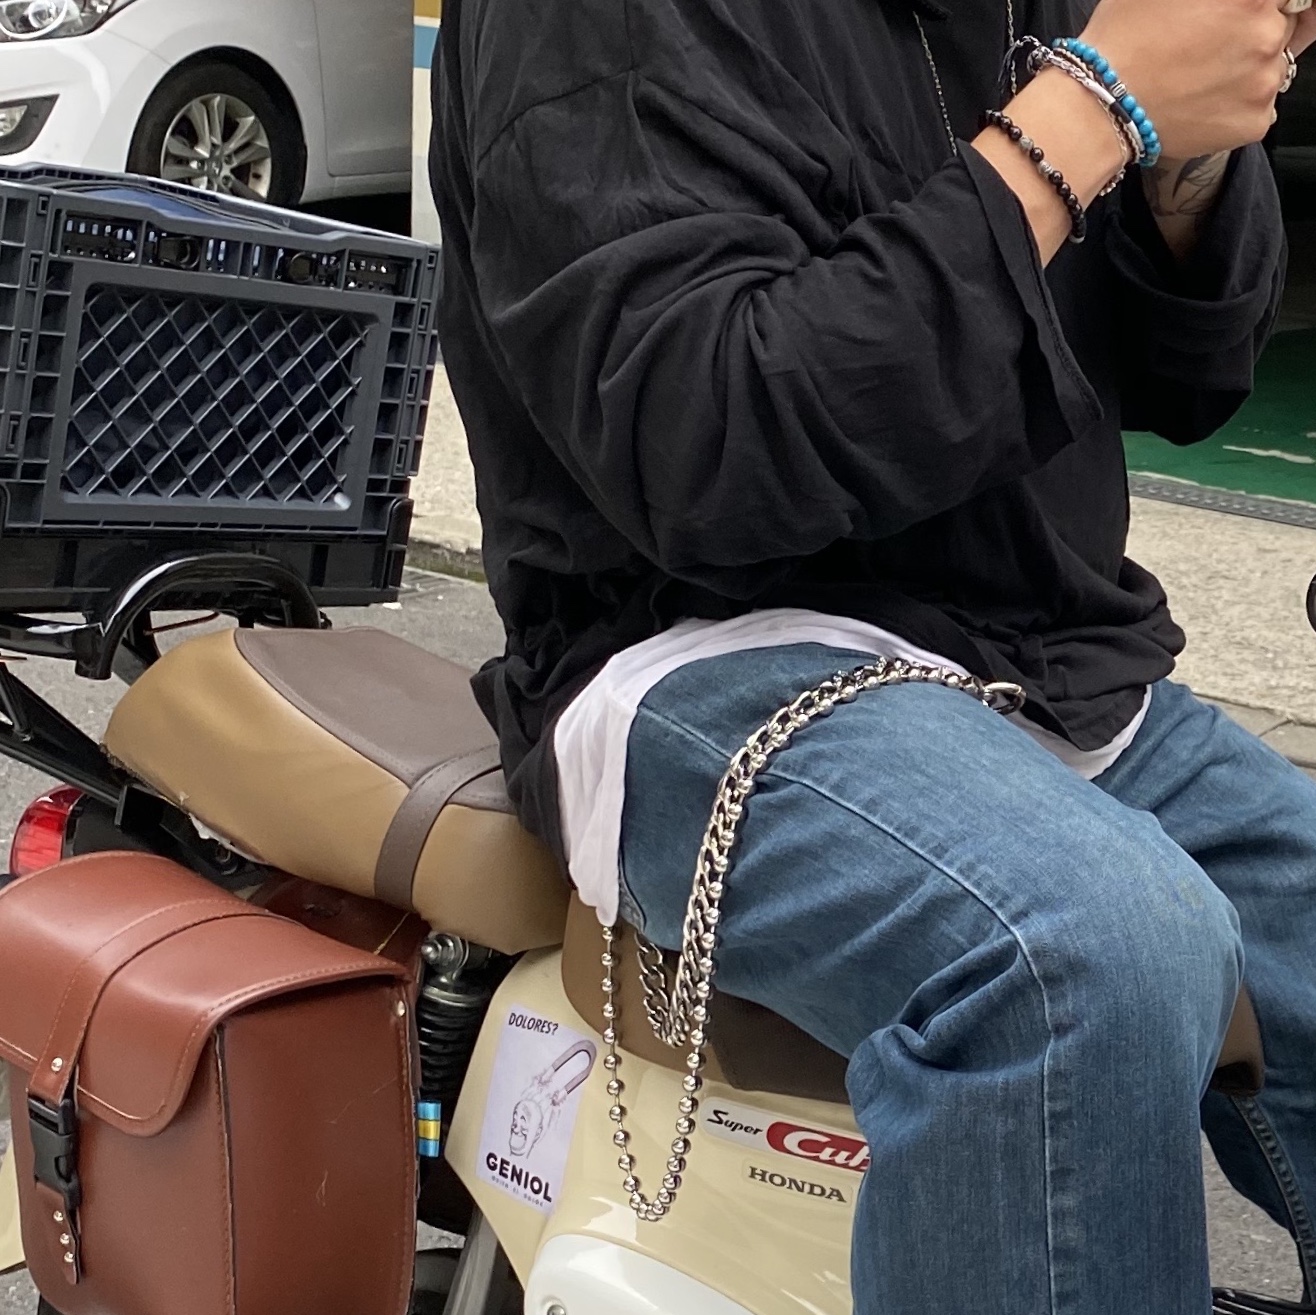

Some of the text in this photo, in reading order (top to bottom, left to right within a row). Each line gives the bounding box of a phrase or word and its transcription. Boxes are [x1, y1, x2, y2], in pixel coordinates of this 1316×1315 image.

[508, 1012, 559, 1036] DOLORES?
[706, 1109, 764, 1136] Super
[486, 1152, 553, 1203] GENIOL
[748, 1165, 848, 1203] HONDA
